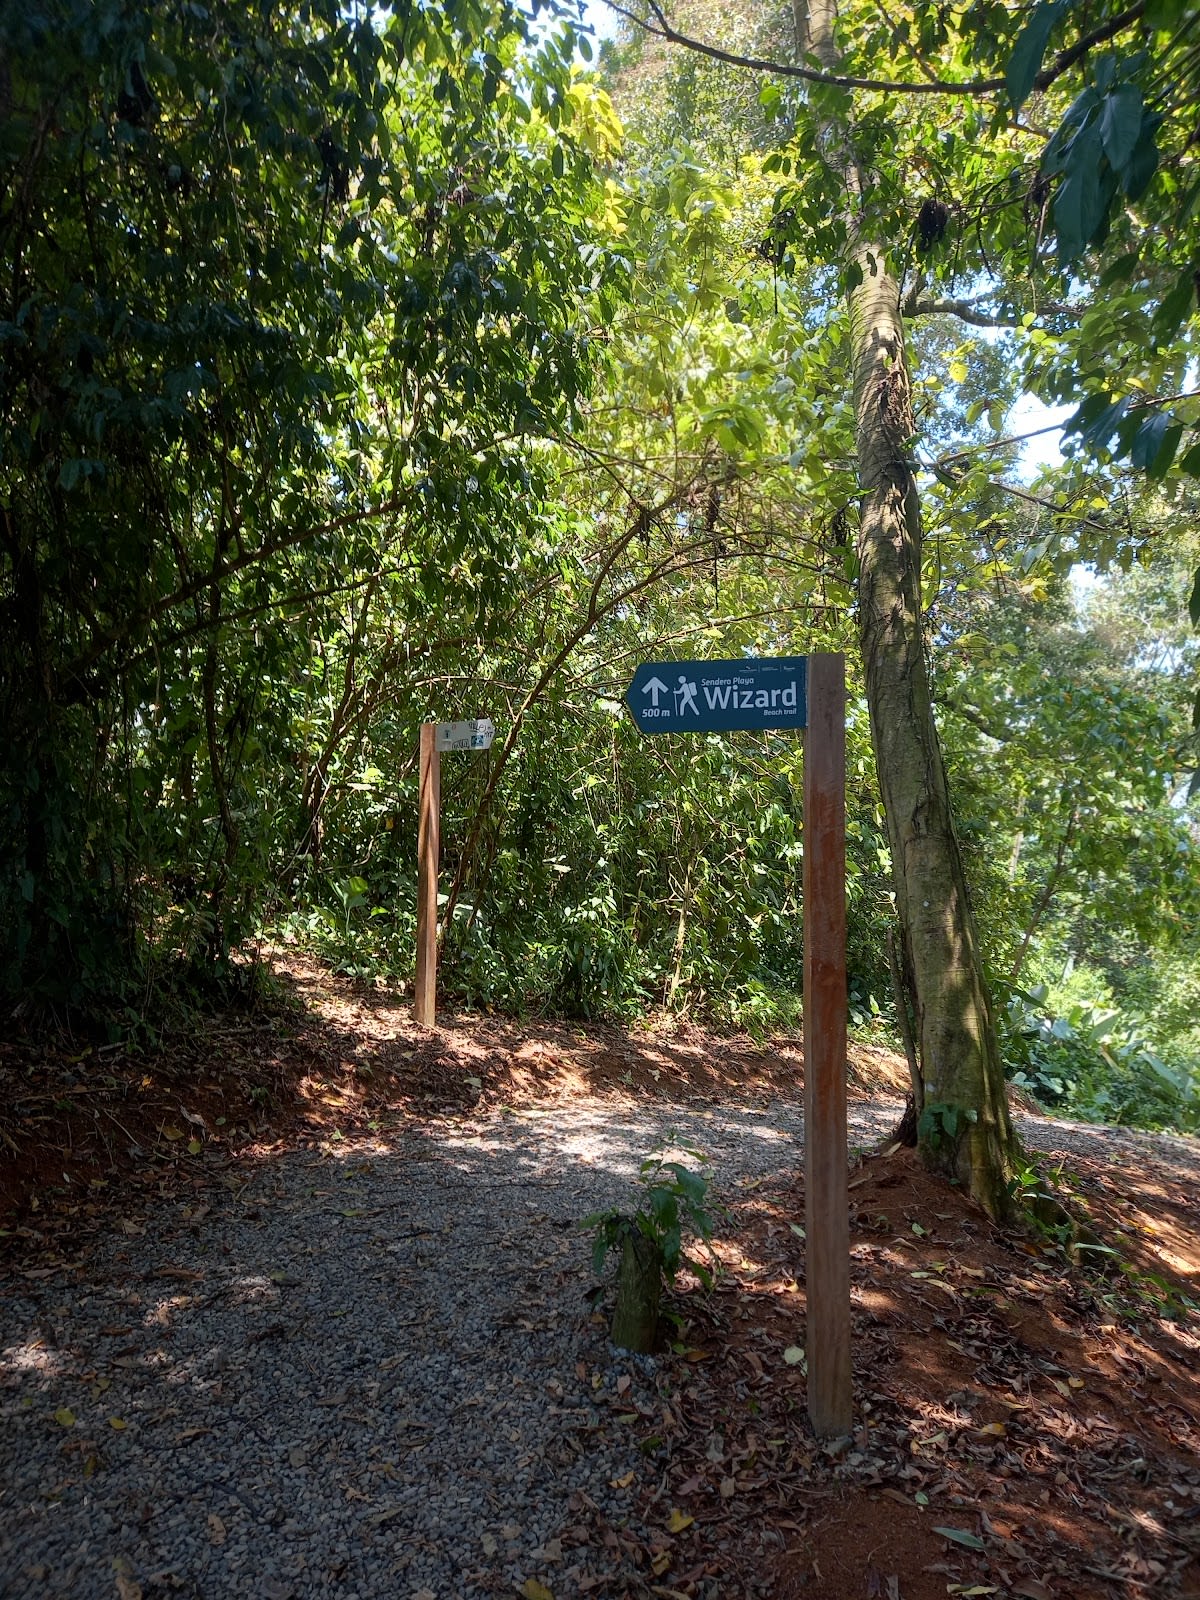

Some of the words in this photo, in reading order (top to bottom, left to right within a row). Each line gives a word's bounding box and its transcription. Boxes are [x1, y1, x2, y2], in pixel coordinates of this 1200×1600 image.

[701, 677, 731, 686] Sendero
[732, 676, 754, 686] Playa
[703, 681, 797, 710] Wizard
[641, 708, 660, 718] 500
[661, 709, 671, 717] m
